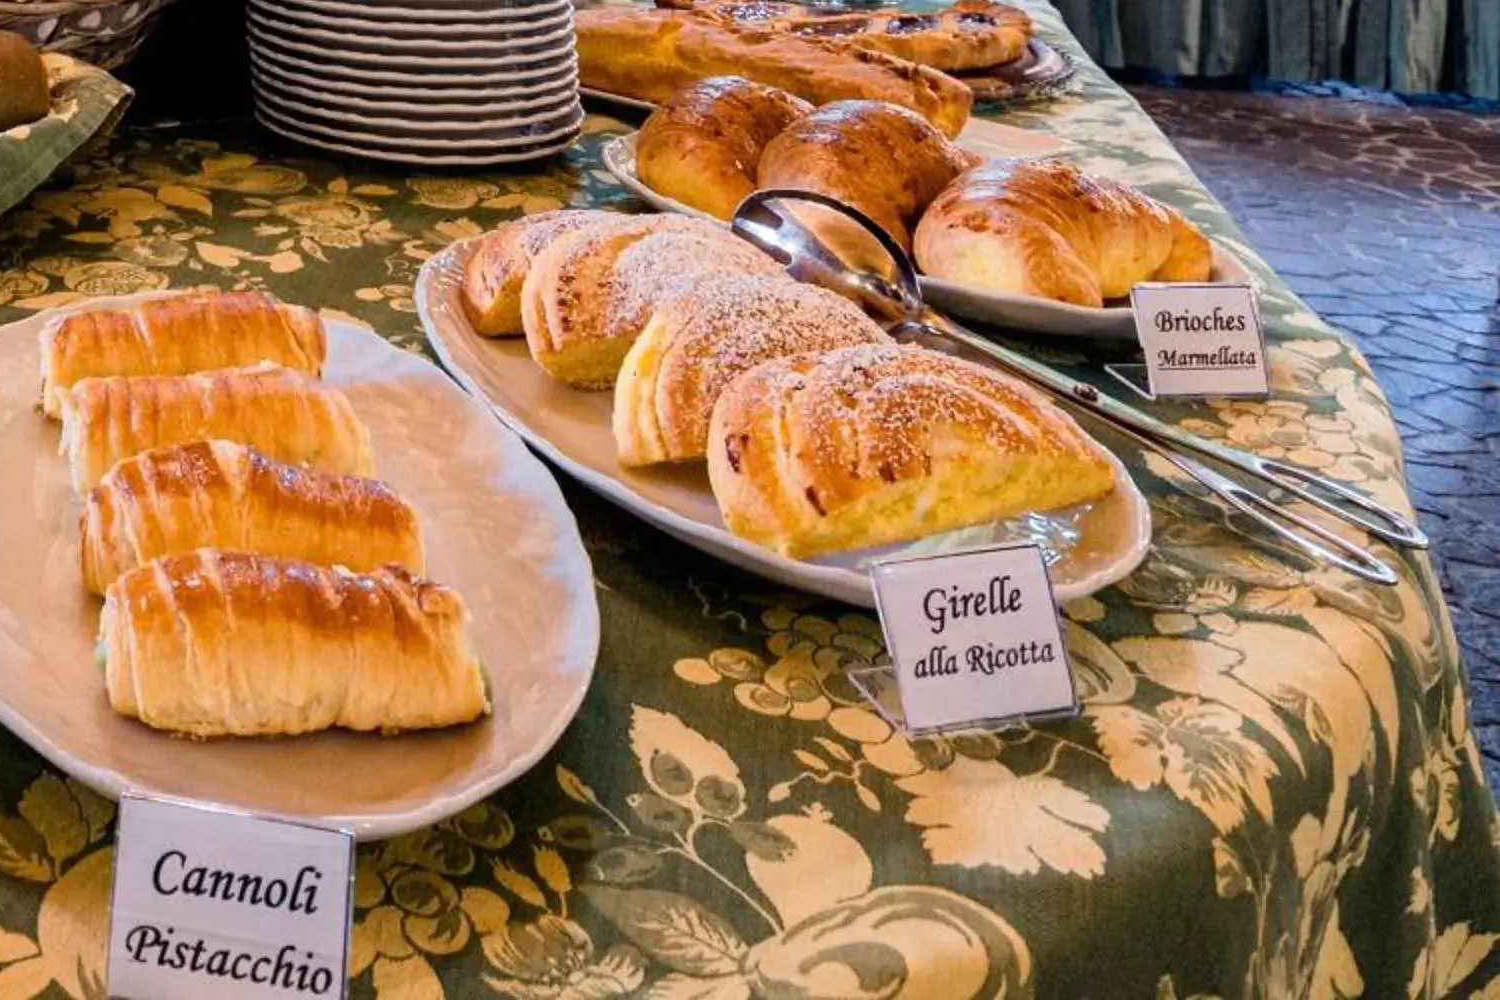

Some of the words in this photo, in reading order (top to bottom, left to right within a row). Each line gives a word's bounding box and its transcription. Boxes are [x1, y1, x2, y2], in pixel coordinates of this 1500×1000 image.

[1155, 307, 1246, 333] Brioches
[1156, 345, 1257, 367] Marmellata
[923, 575, 1022, 634] Girelle
[913, 646, 960, 678] alla
[965, 641, 1055, 676] Ricotta
[152, 850, 323, 914] Cannoli
[125, 925, 333, 995] Pistacchio
